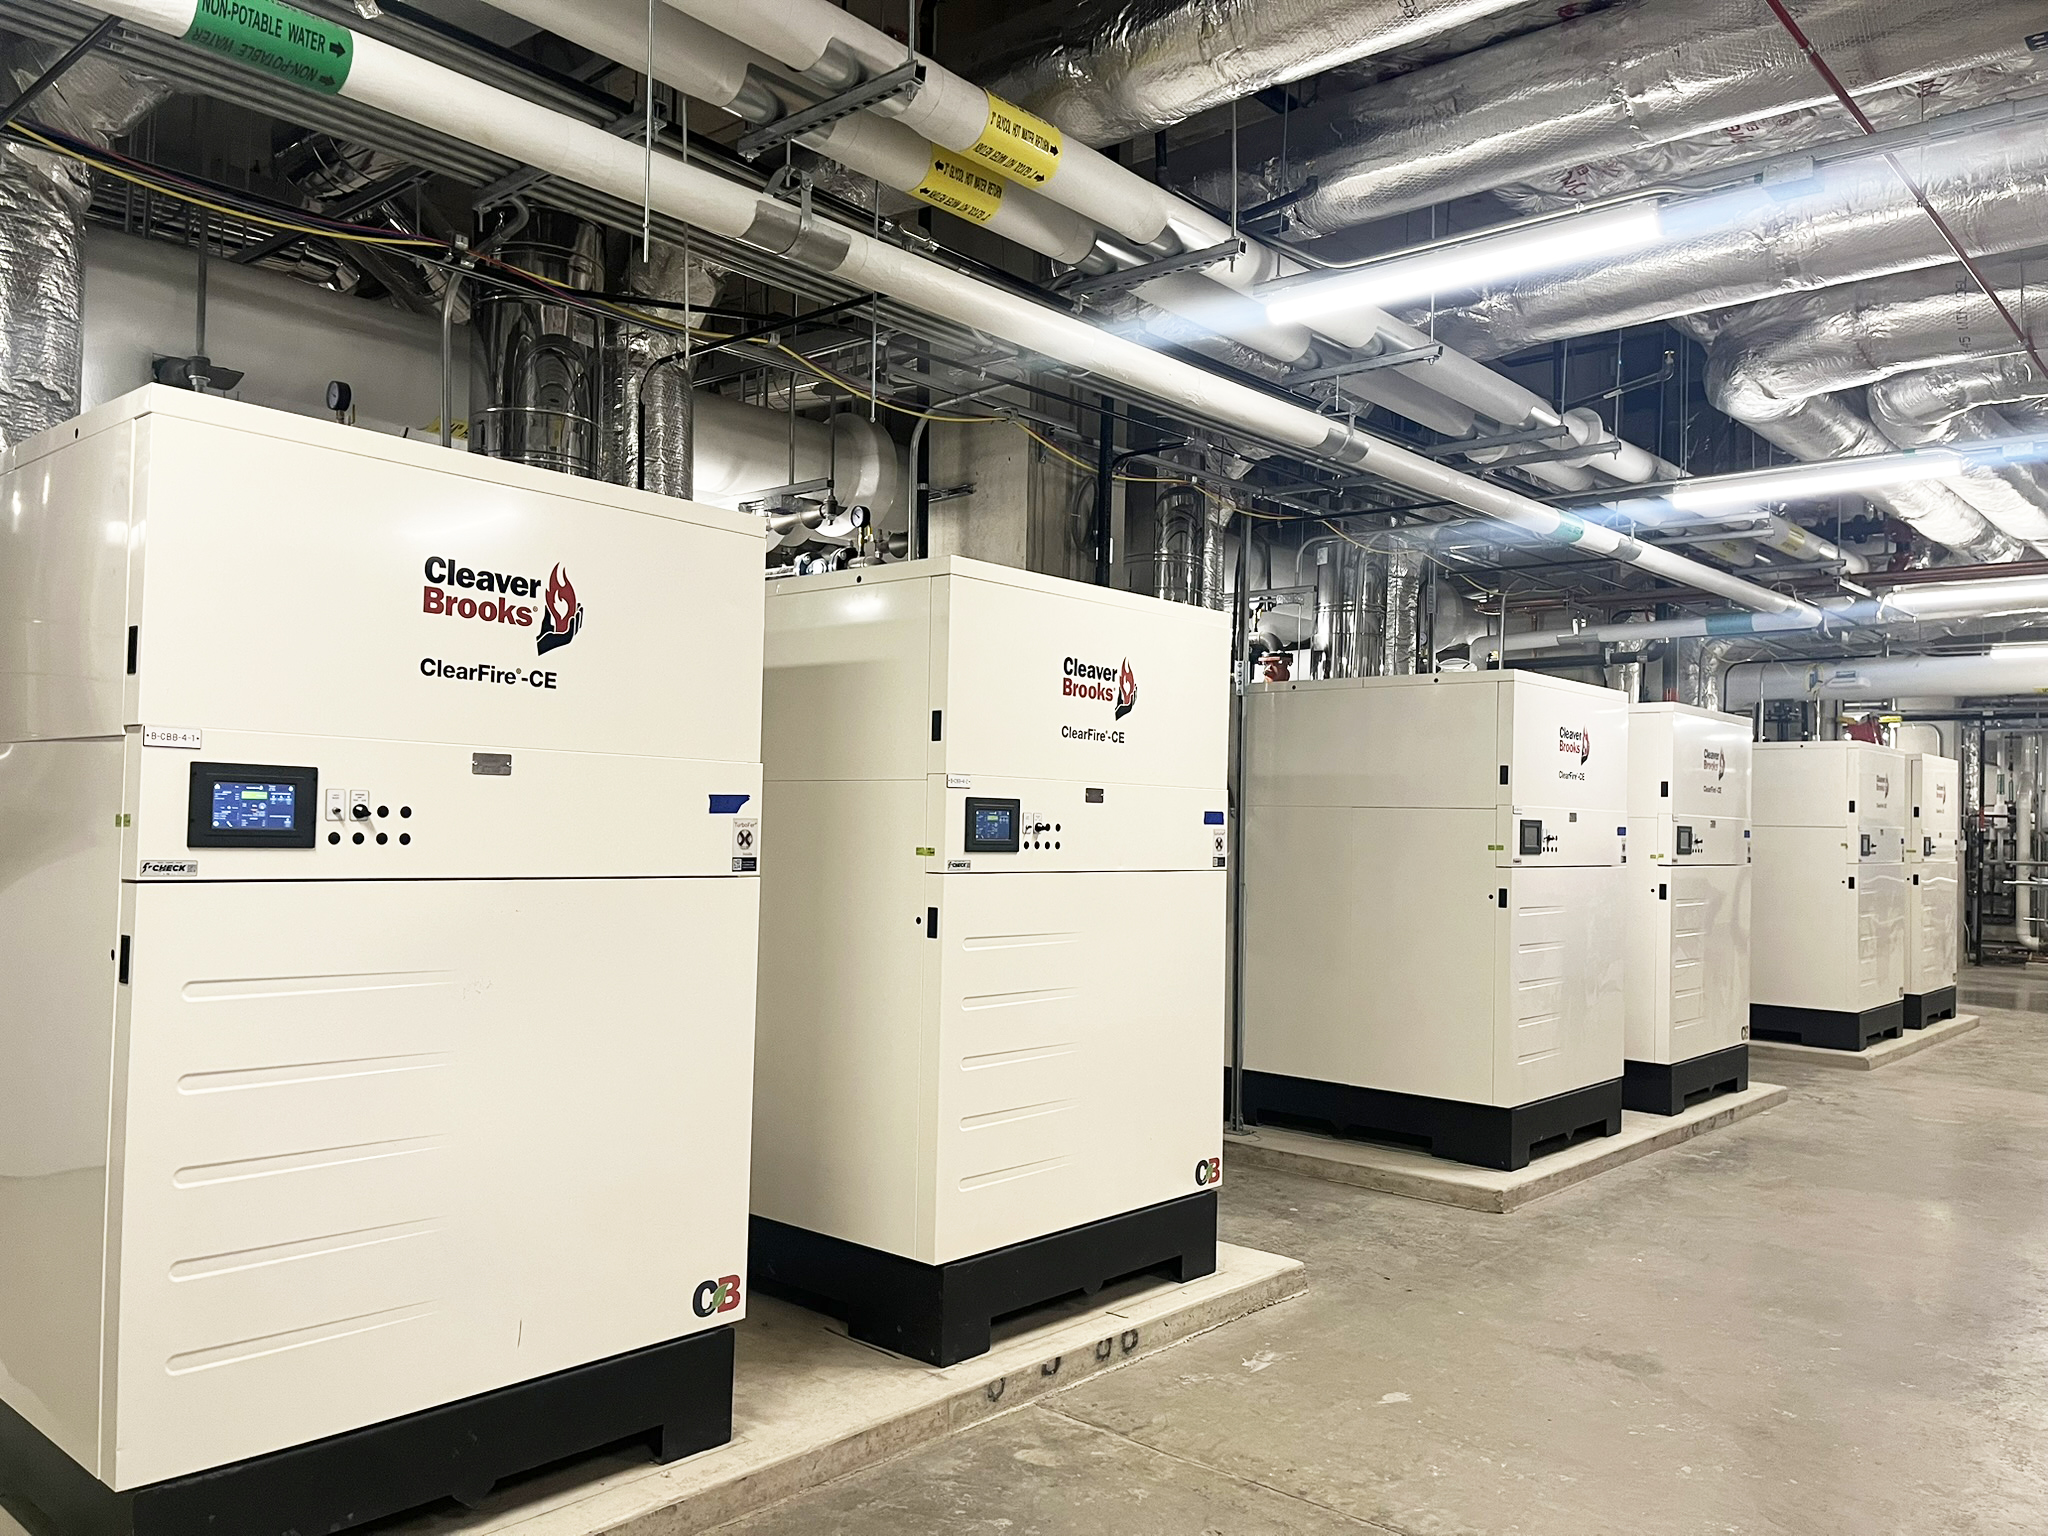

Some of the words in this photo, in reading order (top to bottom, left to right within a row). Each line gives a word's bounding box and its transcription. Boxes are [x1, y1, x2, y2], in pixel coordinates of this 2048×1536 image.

[191, 27, 236, 52] WATER
[202, 0, 283, 39] NON-POTABLE
[288, 22, 325, 54] WATER
[236, 43, 319, 82] NON-POTABLE
[424, 555, 542, 599] Cleaver
[1063, 656, 1118, 683] Cleaver
[1559, 726, 1582, 741] Cleaver
[1194, 1157, 1221, 1187] CB
[692, 1274, 742, 1318] CB
